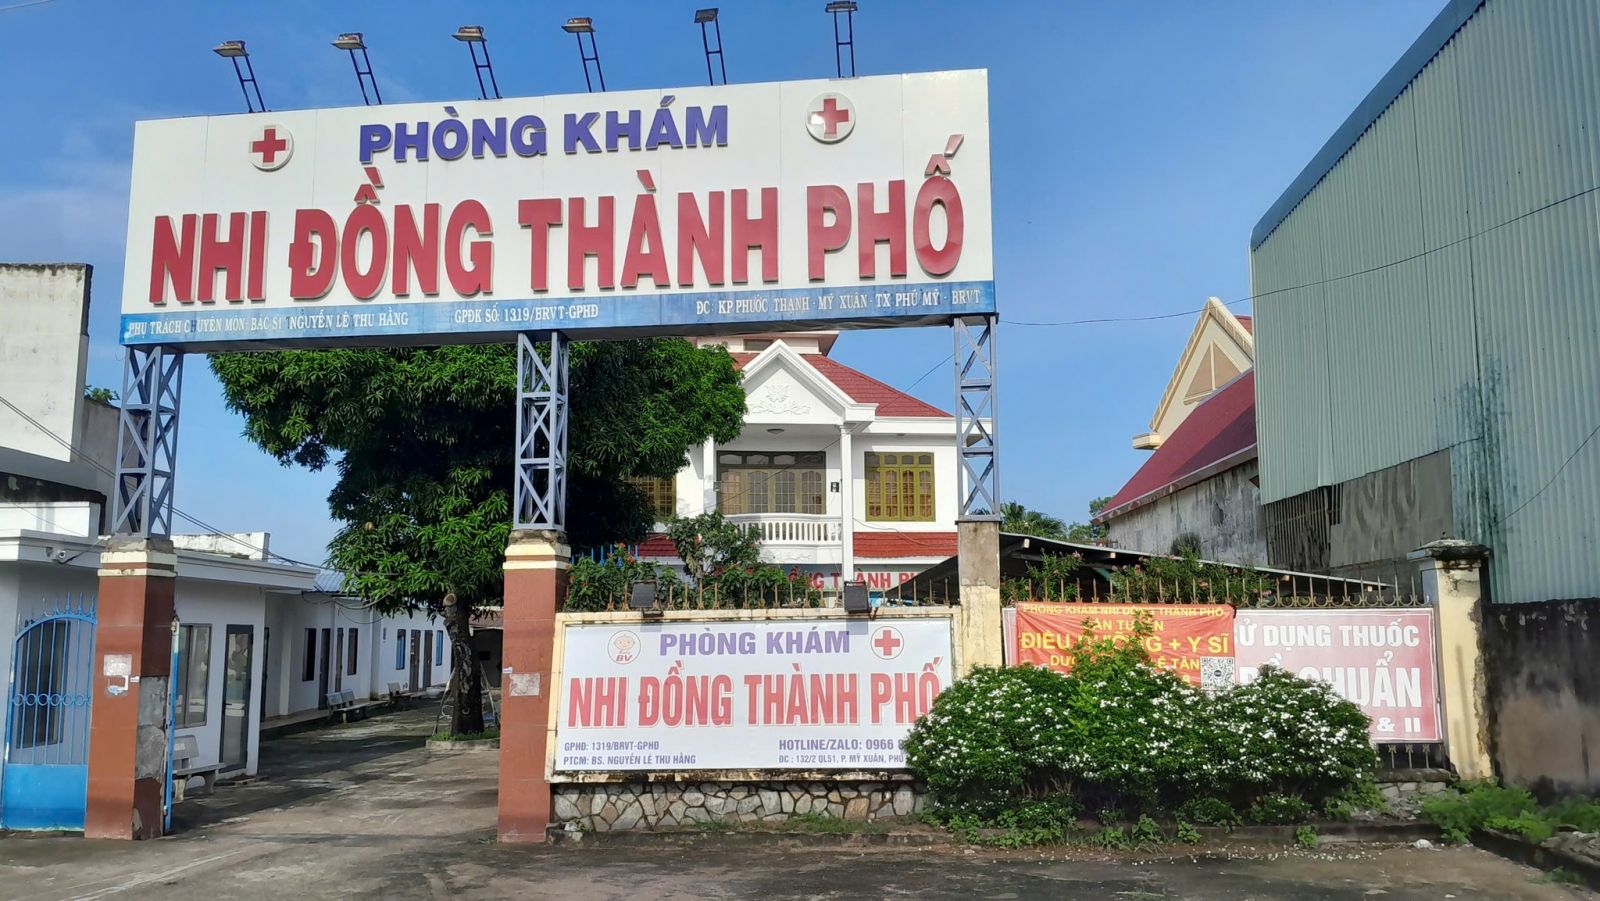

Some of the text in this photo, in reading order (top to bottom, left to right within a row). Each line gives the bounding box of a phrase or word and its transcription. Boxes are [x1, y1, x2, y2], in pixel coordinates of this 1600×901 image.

[359, 95, 728, 164] PHÒNG KHÁM
[149, 134, 965, 305] NHI ĐỒNG THÀNH PHỐ
[718, 300, 734, 314] KP
[735, 294, 768, 313] PHƯỚC
[839, 292, 868, 309] XUÂN
[875, 293, 891, 307] TX
[895, 289, 918, 307] PHÚ
[952, 289, 981, 305] BRVT
[150, 317, 182, 334] TRÁCH
[250, 313, 269, 331] BÁC
[353, 313, 375, 328] THU
[378, 306, 409, 326] HẰNG
[455, 308, 482, 323] GPĐK
[660, 626, 850, 656] PHÒNG KHÁM
[1020, 629, 1070, 650] ĐIỀU
[1187, 636, 1201, 653] Y
[1207, 632, 1230, 653] SĨ
[1263, 625, 1332, 651] DỤNG
[1339, 618, 1420, 647] THUỐC
[567, 656, 942, 728] NHI ĐỒNG THÀNH PHỐ
[779, 738, 862, 751] HOTLINE/ZALO:
[865, 739, 894, 750] 0966
[563, 756, 589, 766] PTCM:
[591, 756, 605, 765] BS.
[655, 755, 671, 764] THU
[796, 754, 817, 764] 132/2
